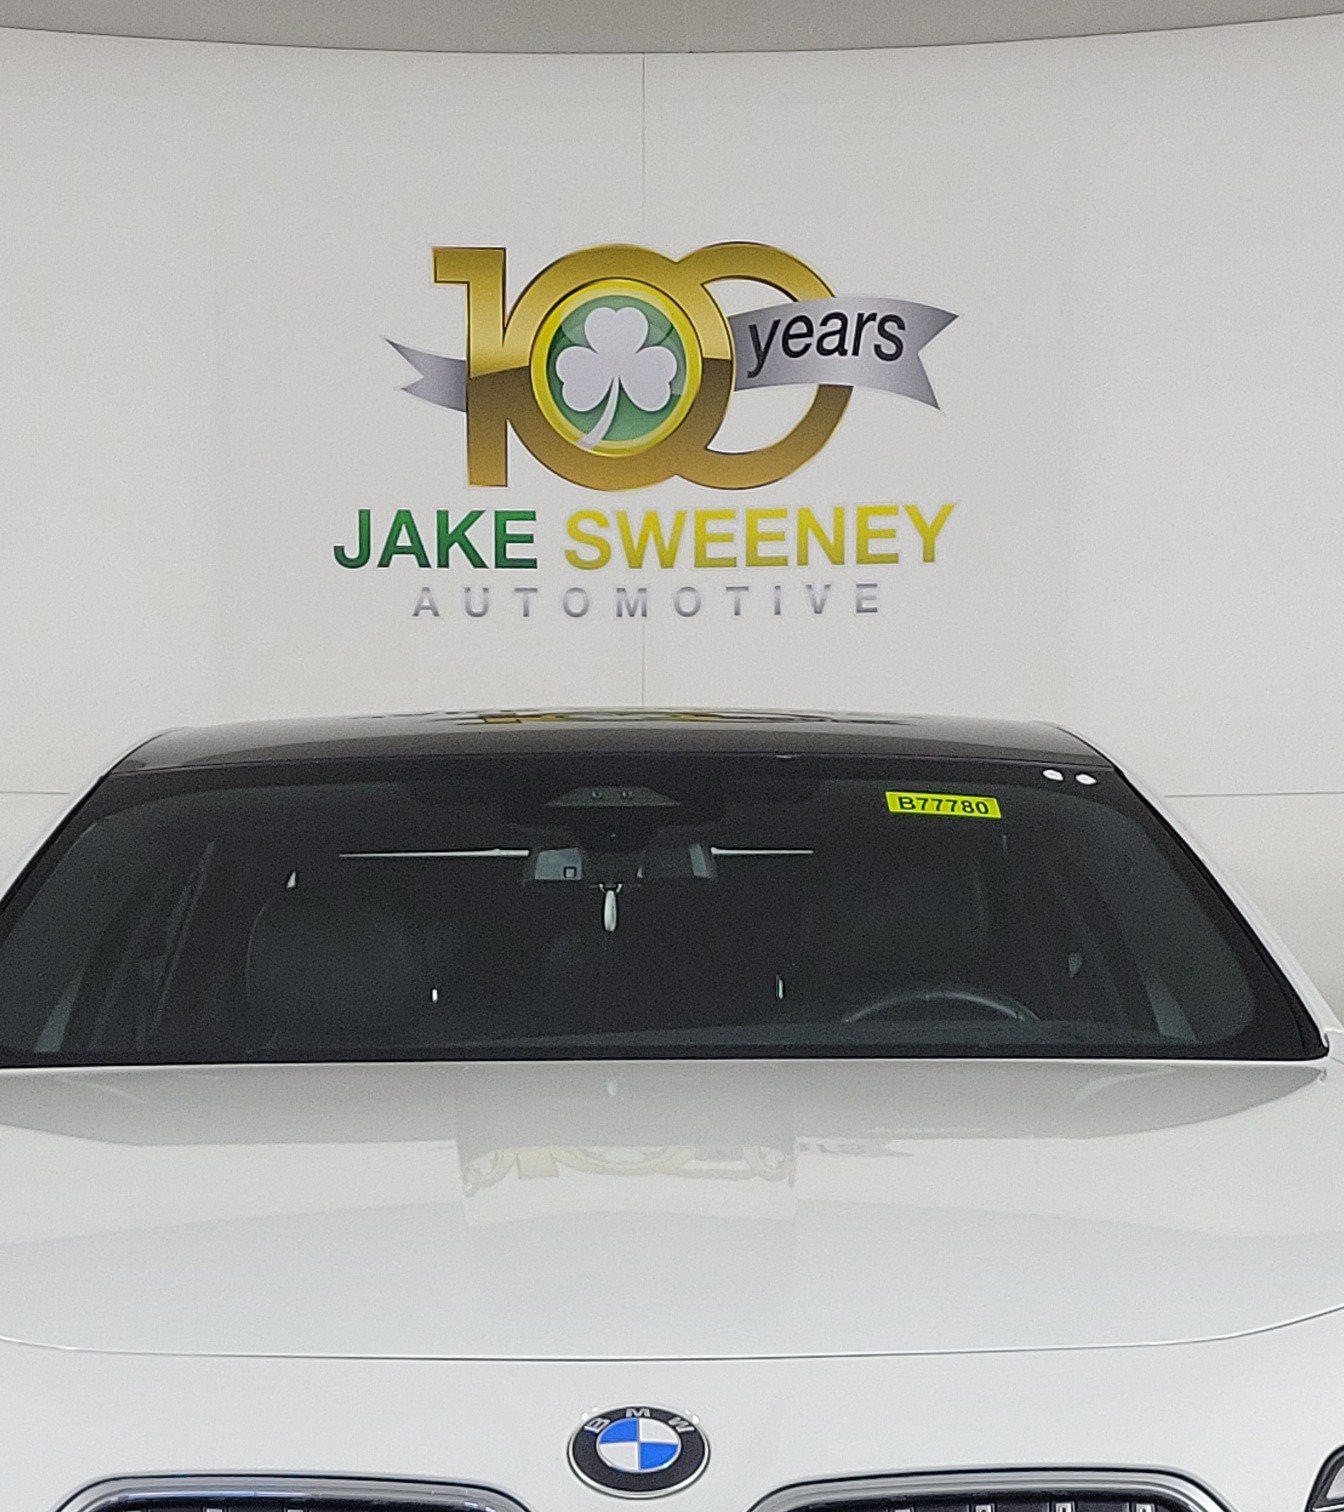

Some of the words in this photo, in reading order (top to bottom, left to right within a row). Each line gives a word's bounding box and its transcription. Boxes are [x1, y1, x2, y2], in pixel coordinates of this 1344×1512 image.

[431, 241, 855, 492] 100
[746, 310, 907, 380] years
[332, 508, 539, 571] JAKE
[563, 504, 956, 570] SWEENEY
[412, 582, 880, 619] AUTOMOTIVE
[897, 796, 990, 815] B77780
[584, 1408, 695, 1434] BMW
